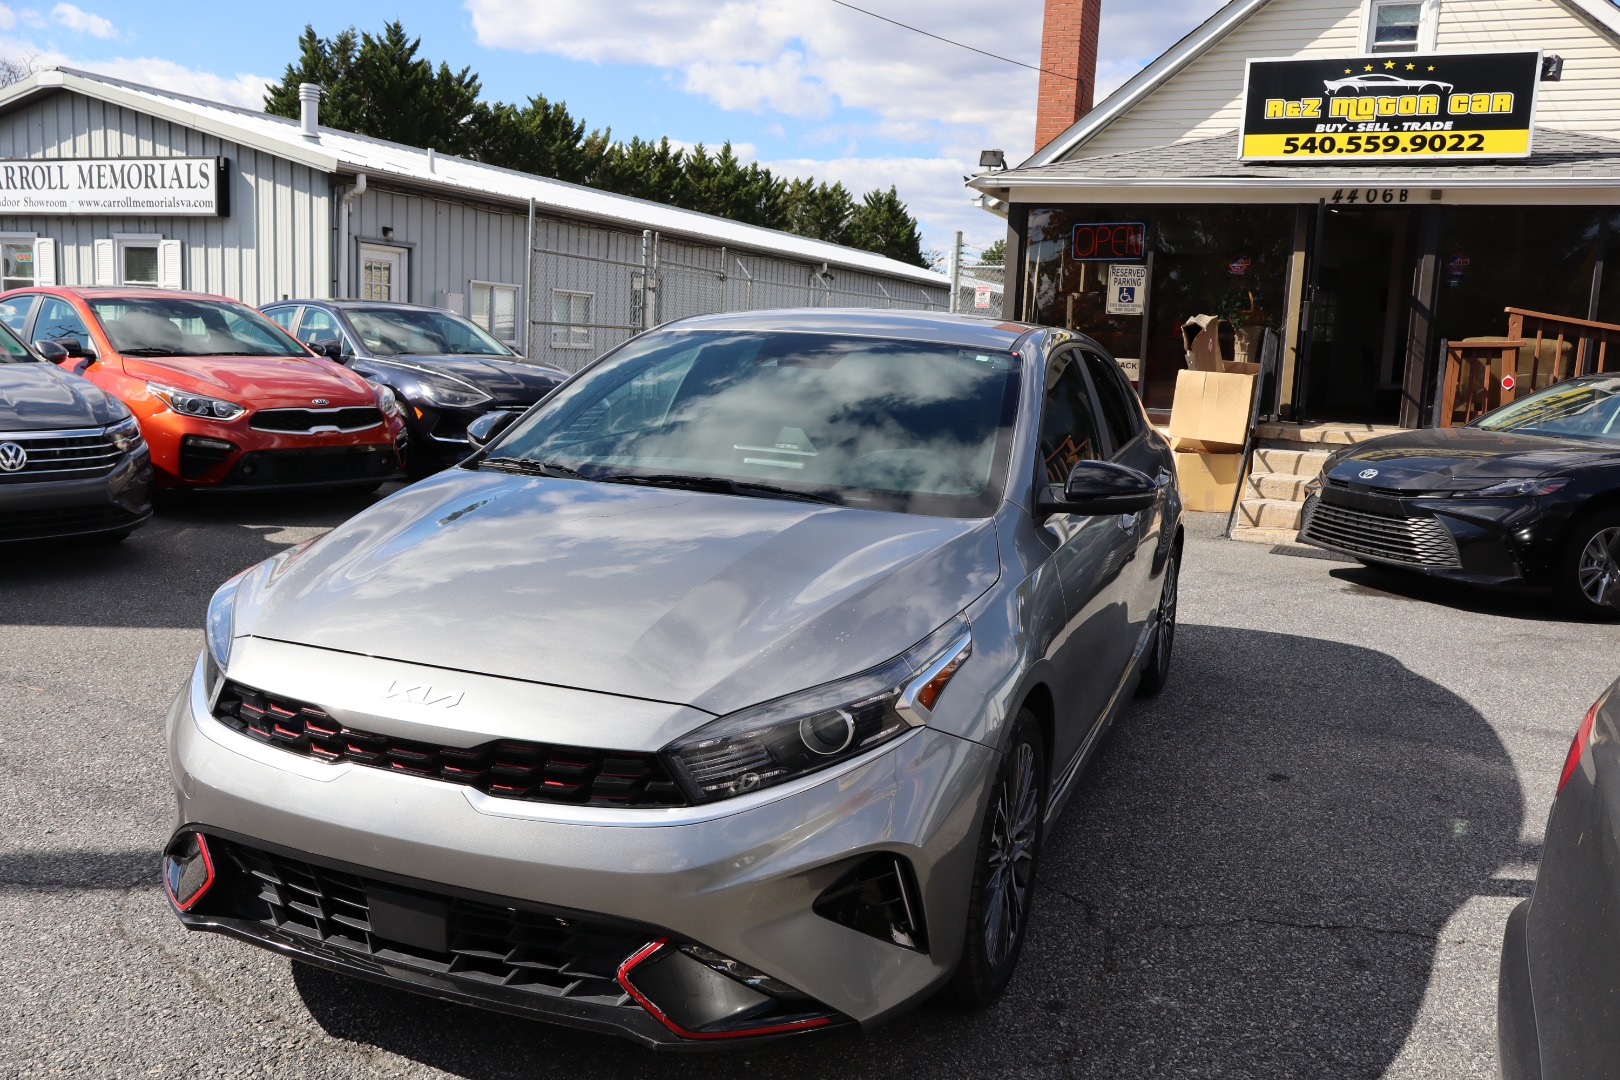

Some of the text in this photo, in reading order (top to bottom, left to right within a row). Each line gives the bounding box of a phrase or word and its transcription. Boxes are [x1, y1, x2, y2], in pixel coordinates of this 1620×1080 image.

[1264, 98, 1322, 119] R&Z
[1315, 121, 1453, 133] BUY SELL TRADE
[1283, 134, 1485, 154] 540.559.9022
[0, 162, 210, 191] RROLL MEMORIALS
[23, 196, 68, 208] Showroom
[78, 196, 214, 209] www.carrollmemorialsva.com
[1075, 225, 1143, 257] OPEN
[1111, 268, 1146, 277] RESERVED
[1113, 278, 1142, 287] PARKING
[1116, 362, 1137, 370] ACK
